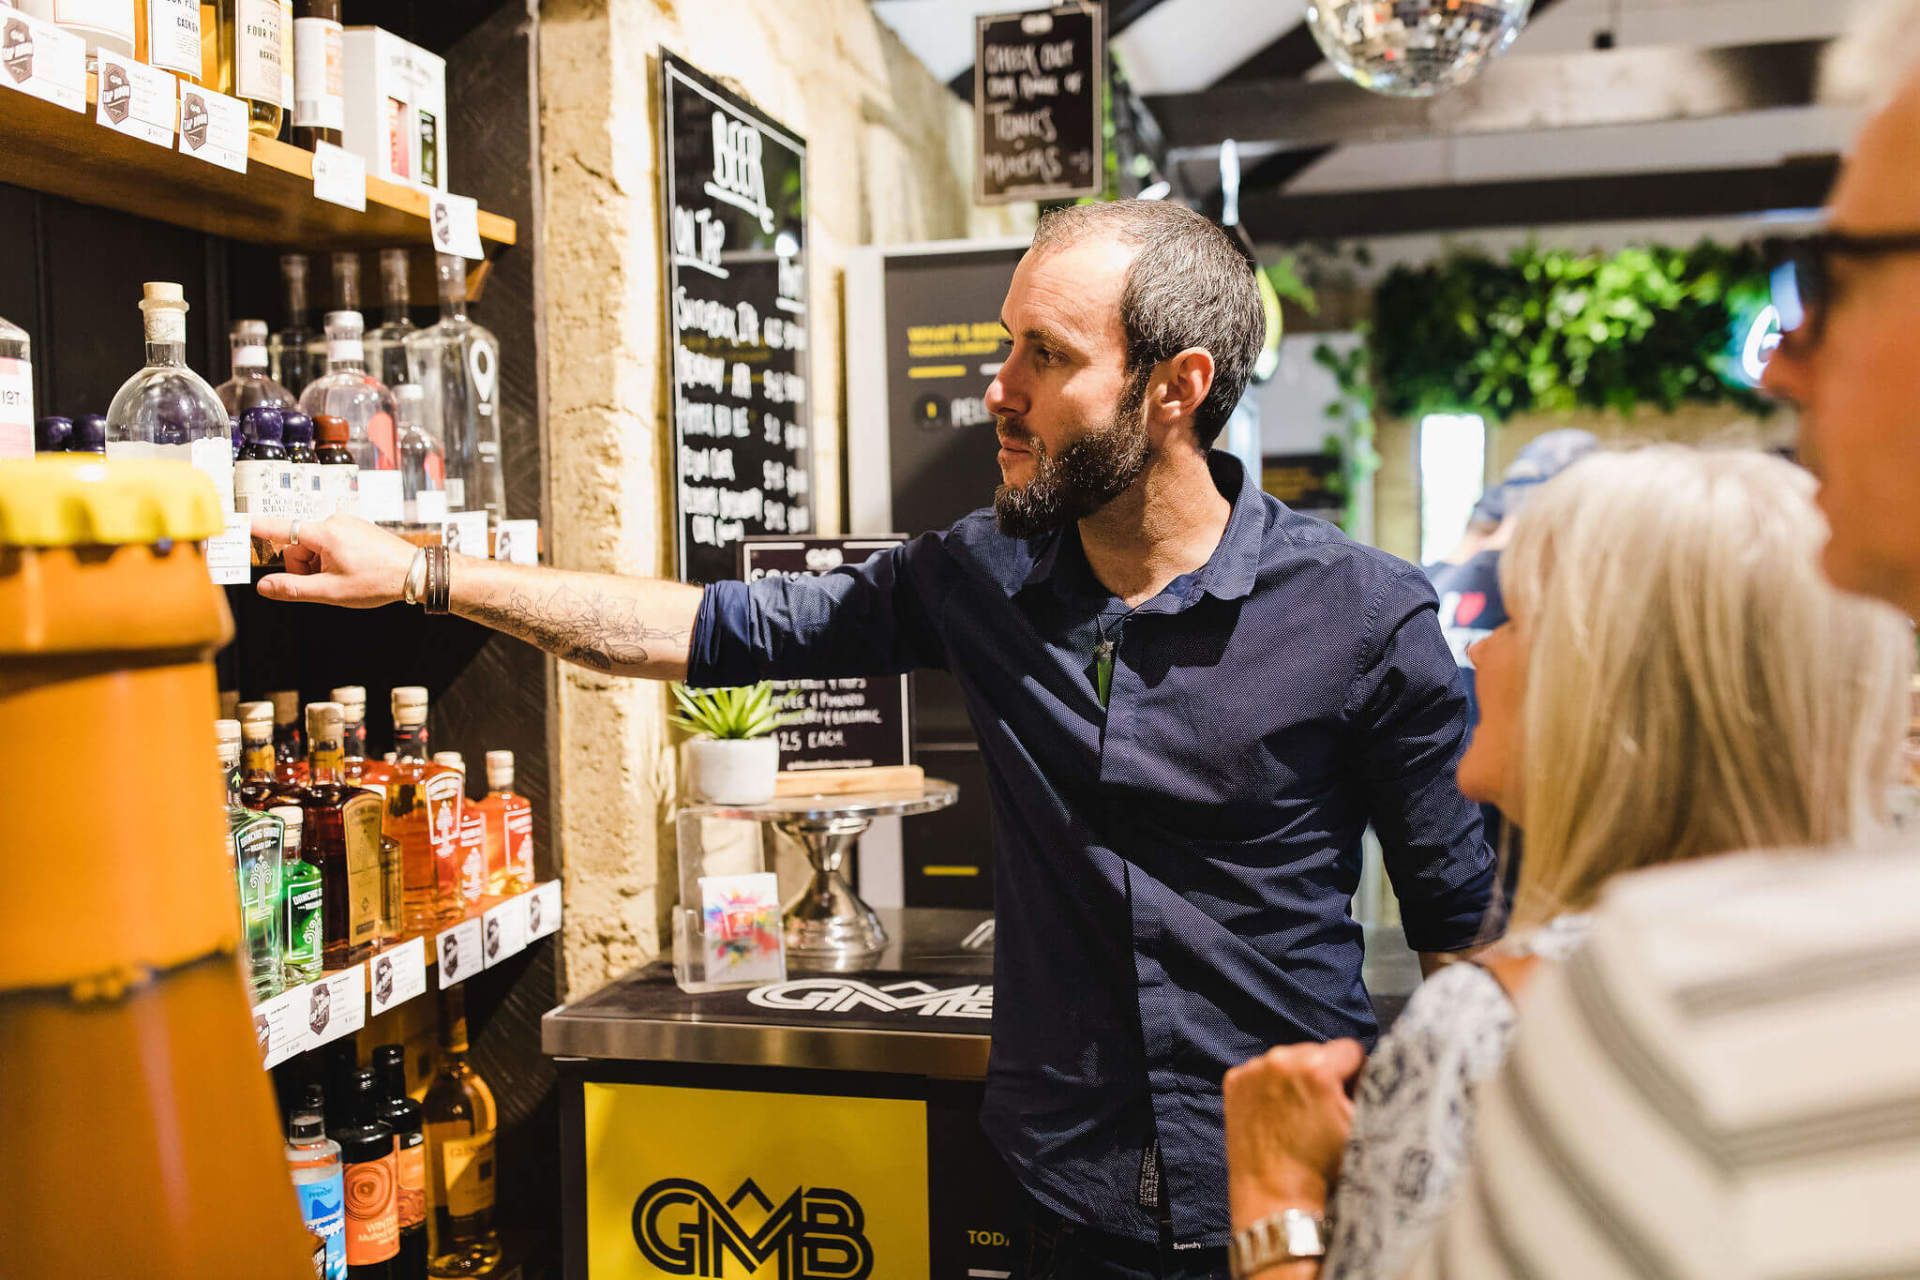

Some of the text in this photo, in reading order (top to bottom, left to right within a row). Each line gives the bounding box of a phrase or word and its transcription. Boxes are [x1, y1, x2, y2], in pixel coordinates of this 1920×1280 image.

[247, 24, 267, 40] FOUR
[632, 1177, 874, 1280] GMB
[1173, 1241, 1202, 1251] Superdry
